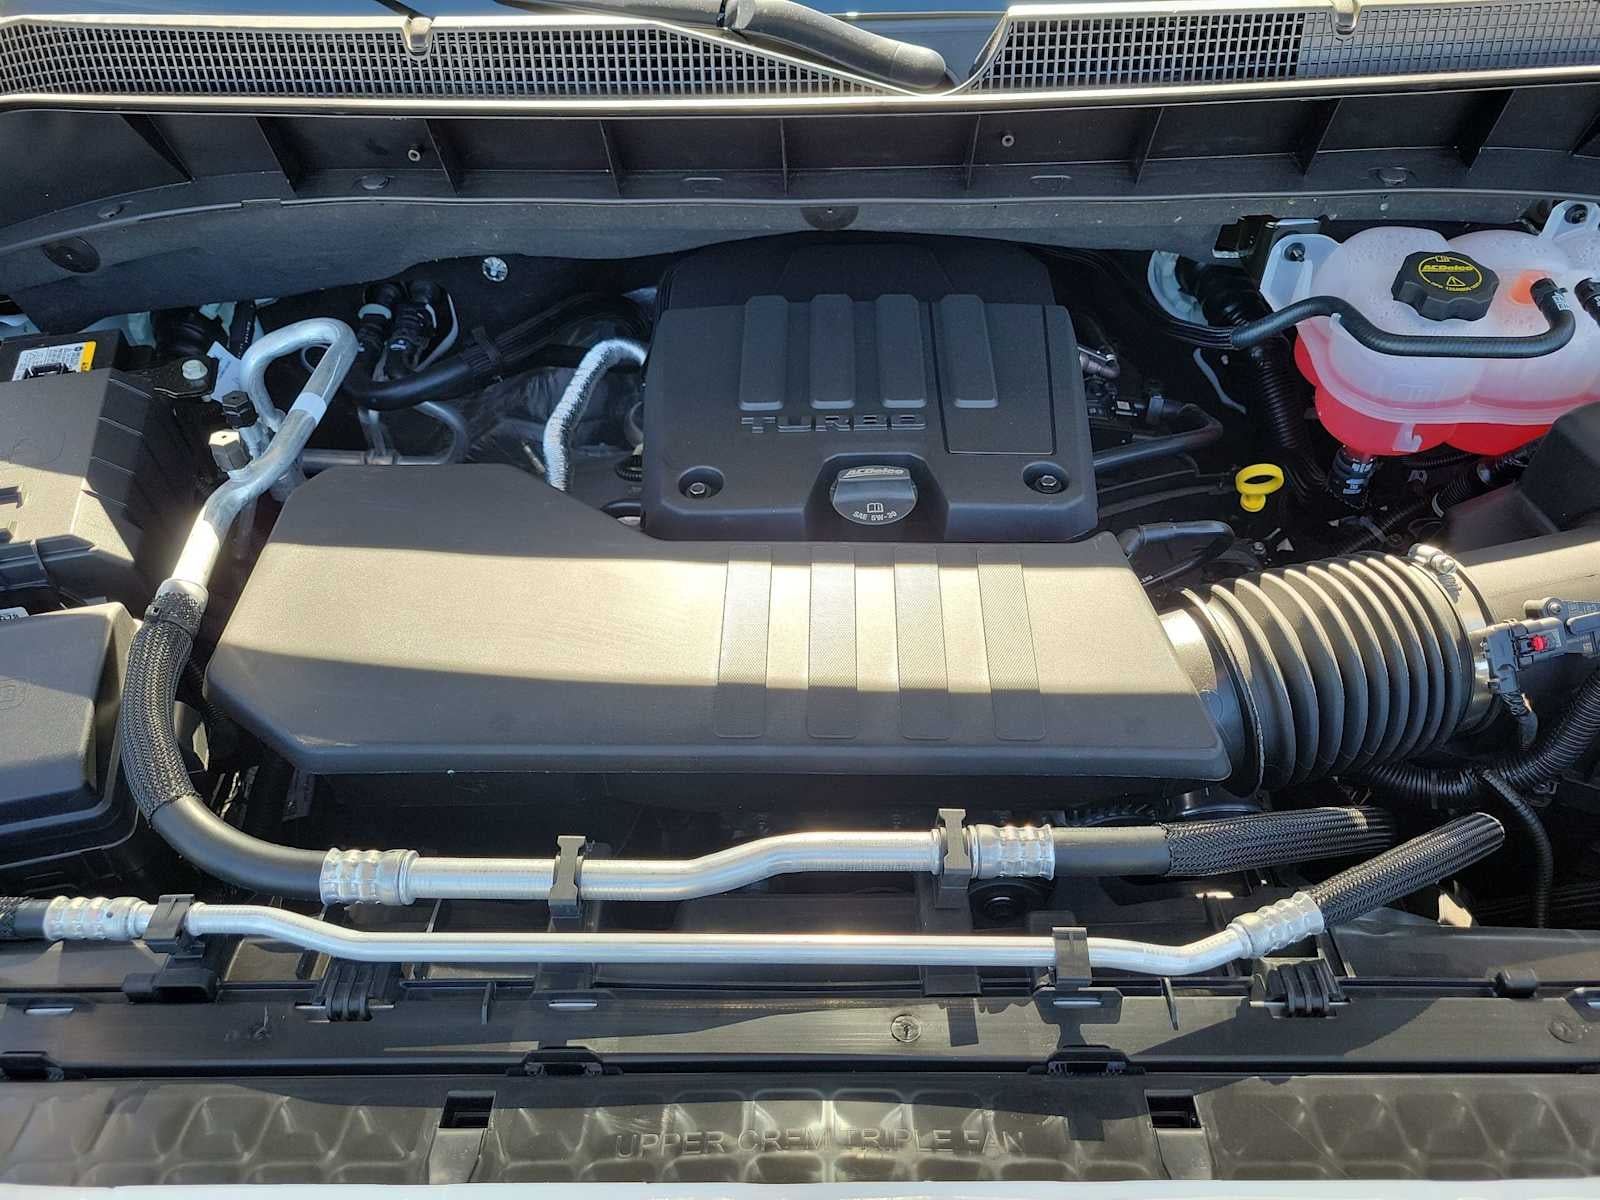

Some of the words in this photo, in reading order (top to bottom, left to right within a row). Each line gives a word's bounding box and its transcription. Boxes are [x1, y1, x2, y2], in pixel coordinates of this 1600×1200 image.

[1421, 264, 1474, 273] ACDelco
[741, 414, 927, 434] TURBO
[842, 467, 904, 478] ACDelco
[852, 510, 868, 521] SAE
[616, 1130, 726, 1158] UPPER
[842, 1127, 954, 1153] TRIPLE
[963, 1128, 1025, 1154] FAN
